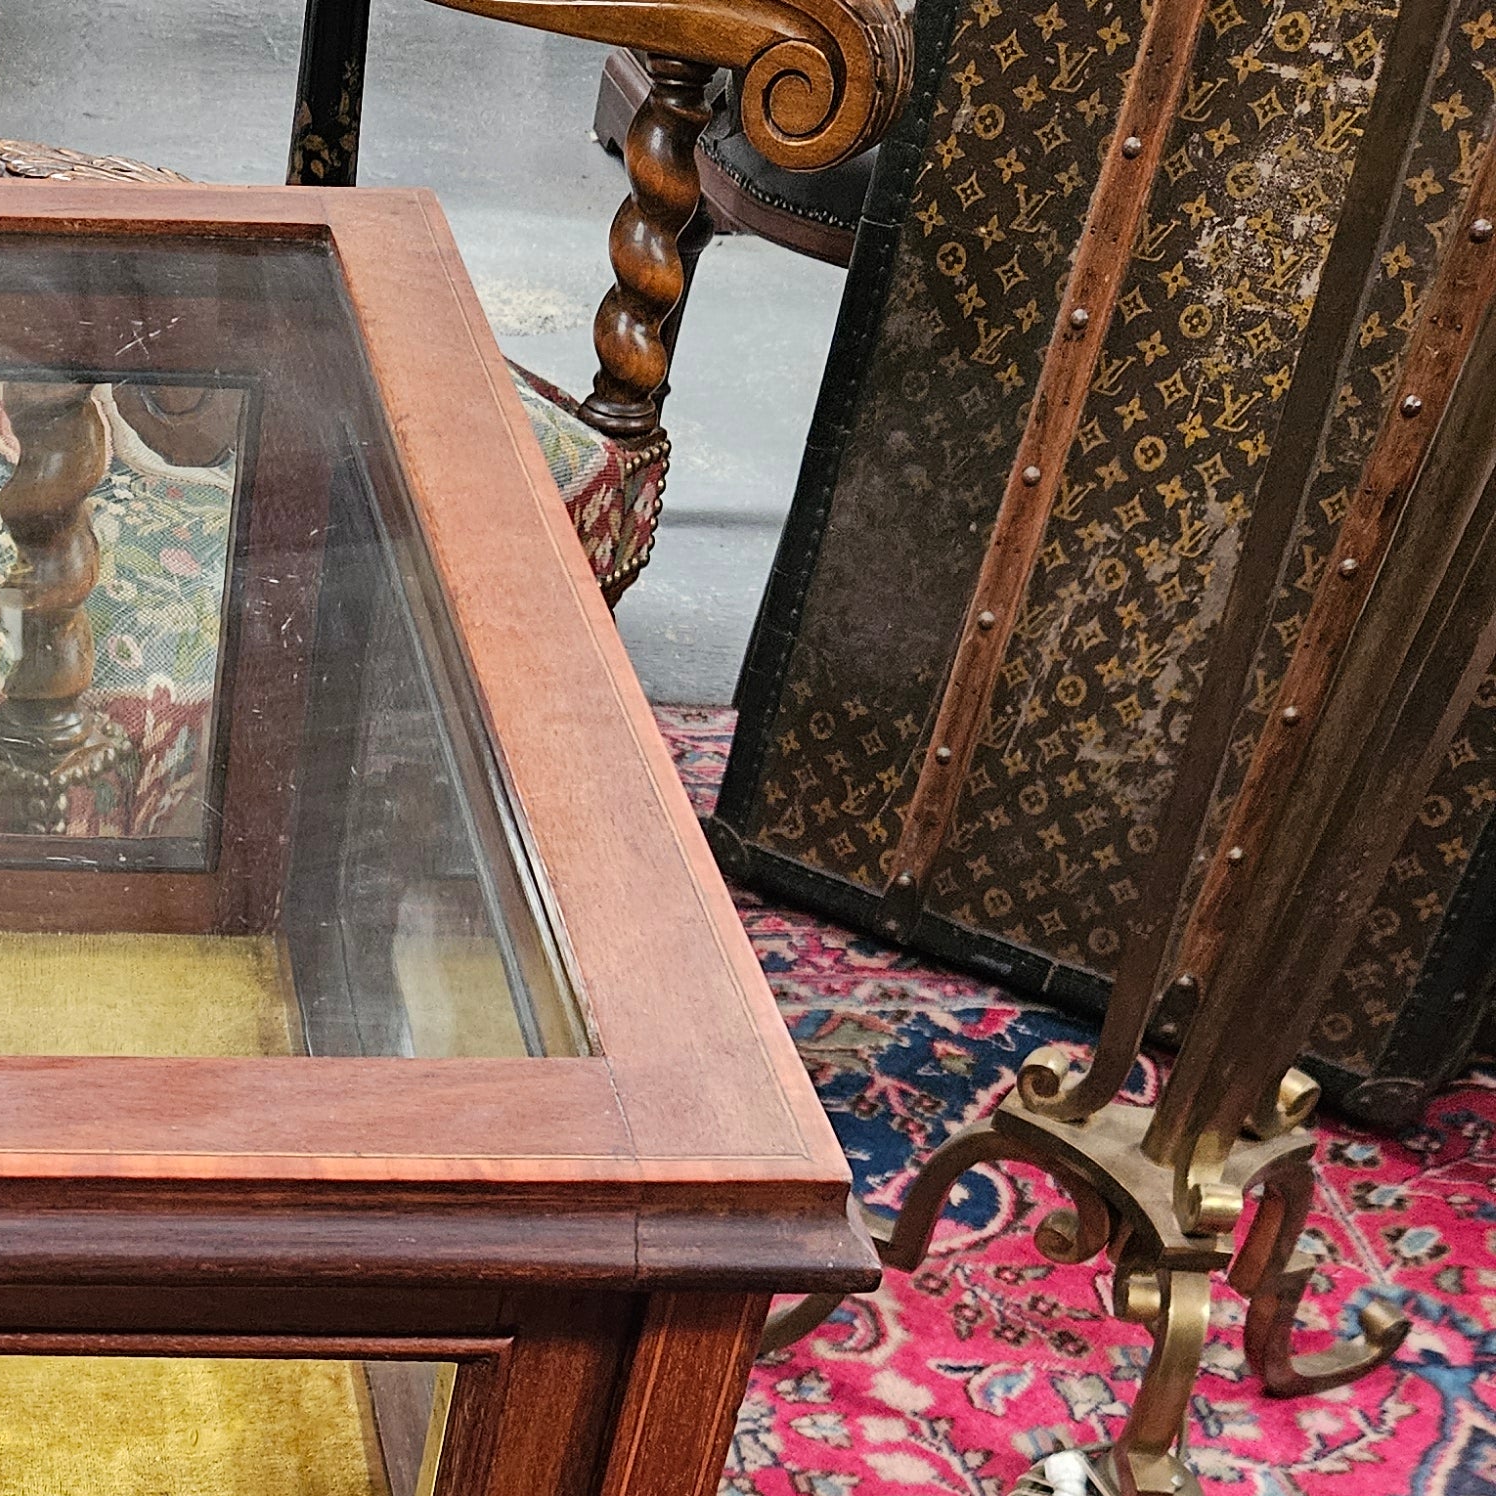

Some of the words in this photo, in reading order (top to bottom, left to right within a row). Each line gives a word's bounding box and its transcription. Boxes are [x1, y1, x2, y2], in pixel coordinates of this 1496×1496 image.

[1050, 42, 1098, 93] LV
[1179, 75, 1229, 122] LV
[1009, 183, 1055, 233] LV
[970, 316, 1015, 365] LV
[1213, 384, 1263, 432] LV
